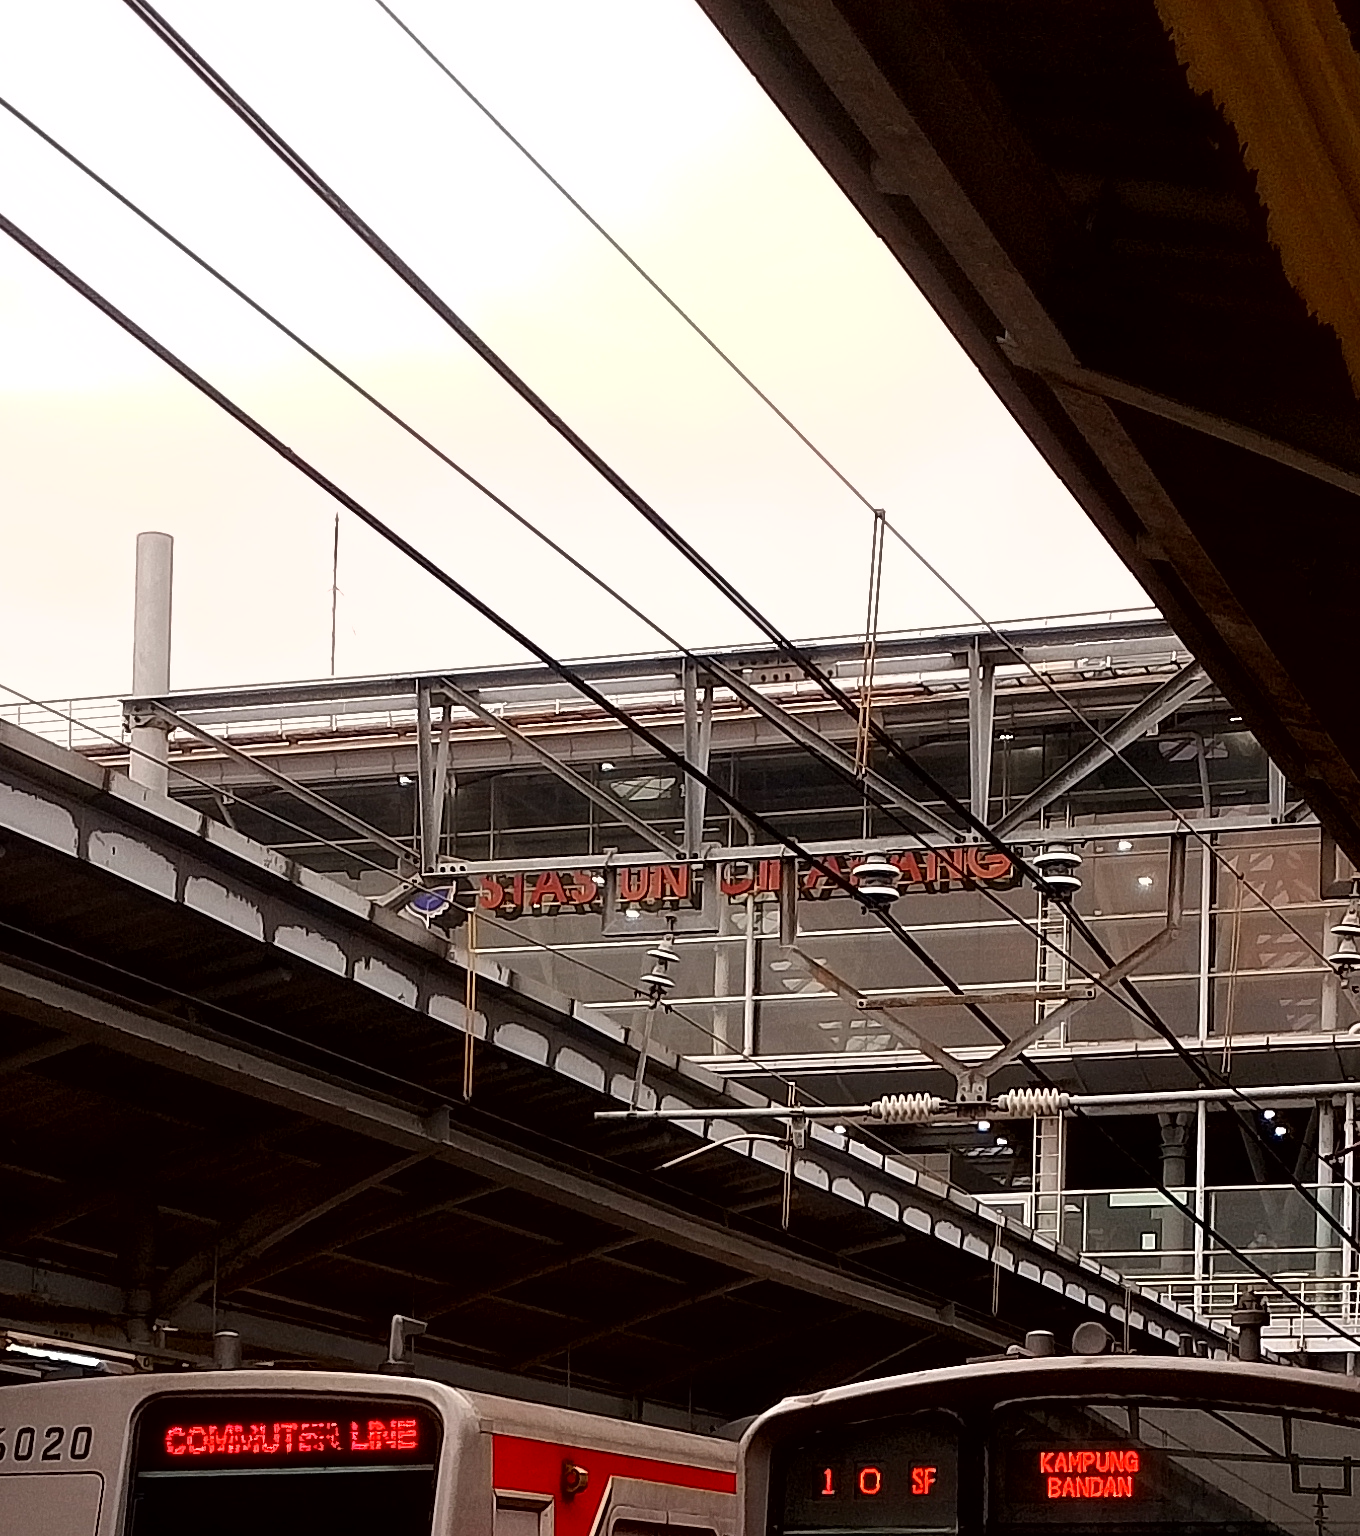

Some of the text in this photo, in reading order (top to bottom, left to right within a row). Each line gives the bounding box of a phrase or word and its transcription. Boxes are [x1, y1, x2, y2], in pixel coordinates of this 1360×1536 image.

[480, 863, 689, 910] STASUN
[165, 1419, 418, 1455] COMMUTER LINE
[1039, 1450, 1140, 1474] KAMPUNG
[1047, 1475, 1134, 1499] BANDAN
